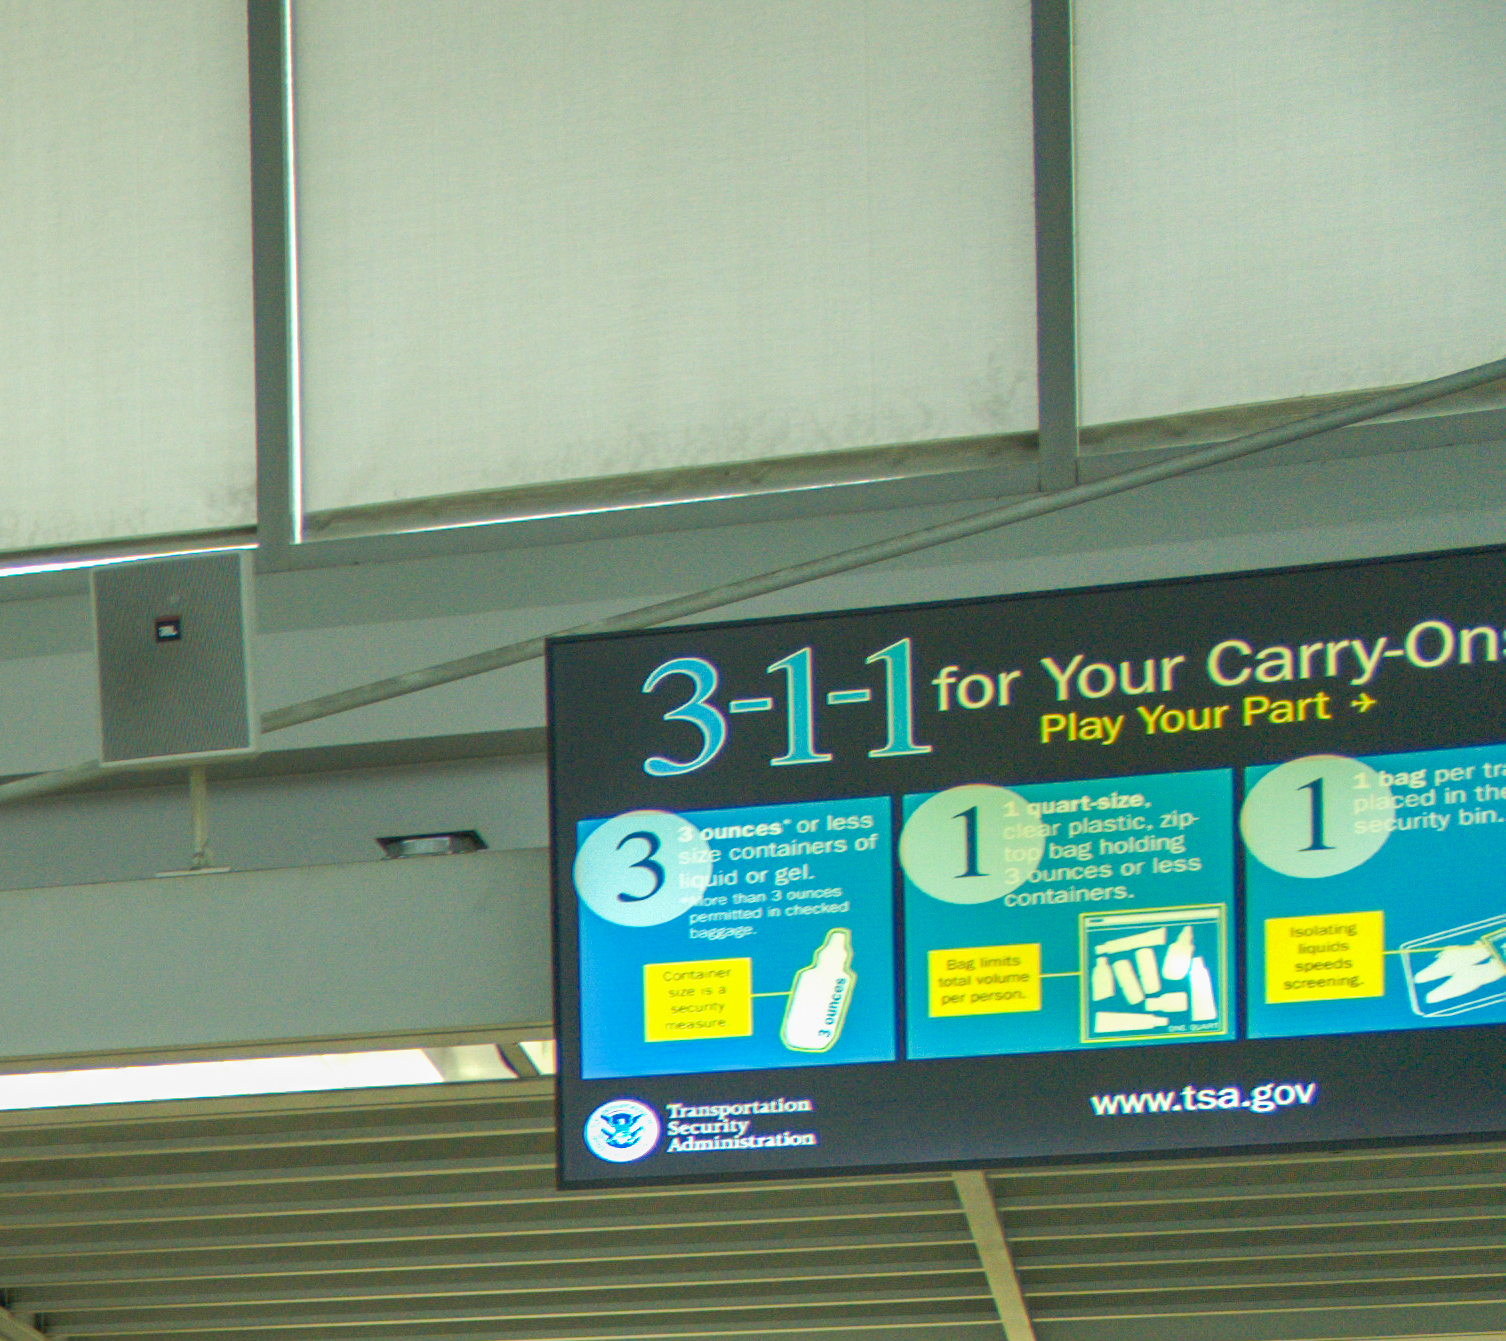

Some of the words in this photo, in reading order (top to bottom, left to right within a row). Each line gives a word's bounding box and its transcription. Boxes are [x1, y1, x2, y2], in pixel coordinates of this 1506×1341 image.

[643, 637, 932, 777] 3-1-1
[931, 665, 1022, 712] for
[1041, 652, 1184, 702] Your
[1040, 715, 1124, 746] Play
[1137, 705, 1230, 736] Your
[1242, 693, 1331, 727] Part
[1379, 769, 1427, 788] bag
[1434, 766, 1476, 786] per
[1028, 792, 1152, 816] quart-size,
[1354, 789, 1436, 815] placed
[1445, 788, 1466, 803] in
[796, 818, 819, 833] or
[827, 814, 874, 831] less
[1069, 815, 1153, 838] plastic,
[1160, 811, 1199, 828] zip-
[1296, 777, 1336, 852] 1
[1354, 812, 1451, 834] security
[1459, 808, 1504, 825] bin.
[729, 839, 848, 861] containers
[855, 834, 878, 851] of
[952, 806, 991, 879] 1
[1049, 842, 1093, 861] bag
[1100, 835, 1186, 855] holding
[616, 831, 665, 903] 3
[746, 870, 767, 885] or
[775, 864, 816, 885] gel.
[1029, 862, 1112, 883] ounces
[1121, 861, 1145, 876] or
[1153, 856, 1202, 874] less
[787, 887, 842, 899] ounces
[1004, 885, 1135, 907] containers.
[785, 901, 849, 916] checked
[1290, 923, 1358, 938] Isolating
[1297, 942, 1349, 955] liquids
[663, 967, 732, 982] Container
[946, 959, 976, 972] Bag
[980, 955, 1021, 968] limits
[1294, 959, 1352, 973] speeds
[938, 975, 971, 987] total
[976, 972, 1030, 984] volume
[942, 994, 966, 1006] per
[666, 1098, 813, 1119] Transportation
[1090, 1082, 1316, 1116] www.tsa.gov
[667, 1119, 750, 1136] Security
[667, 1132, 816, 1152] Administration
